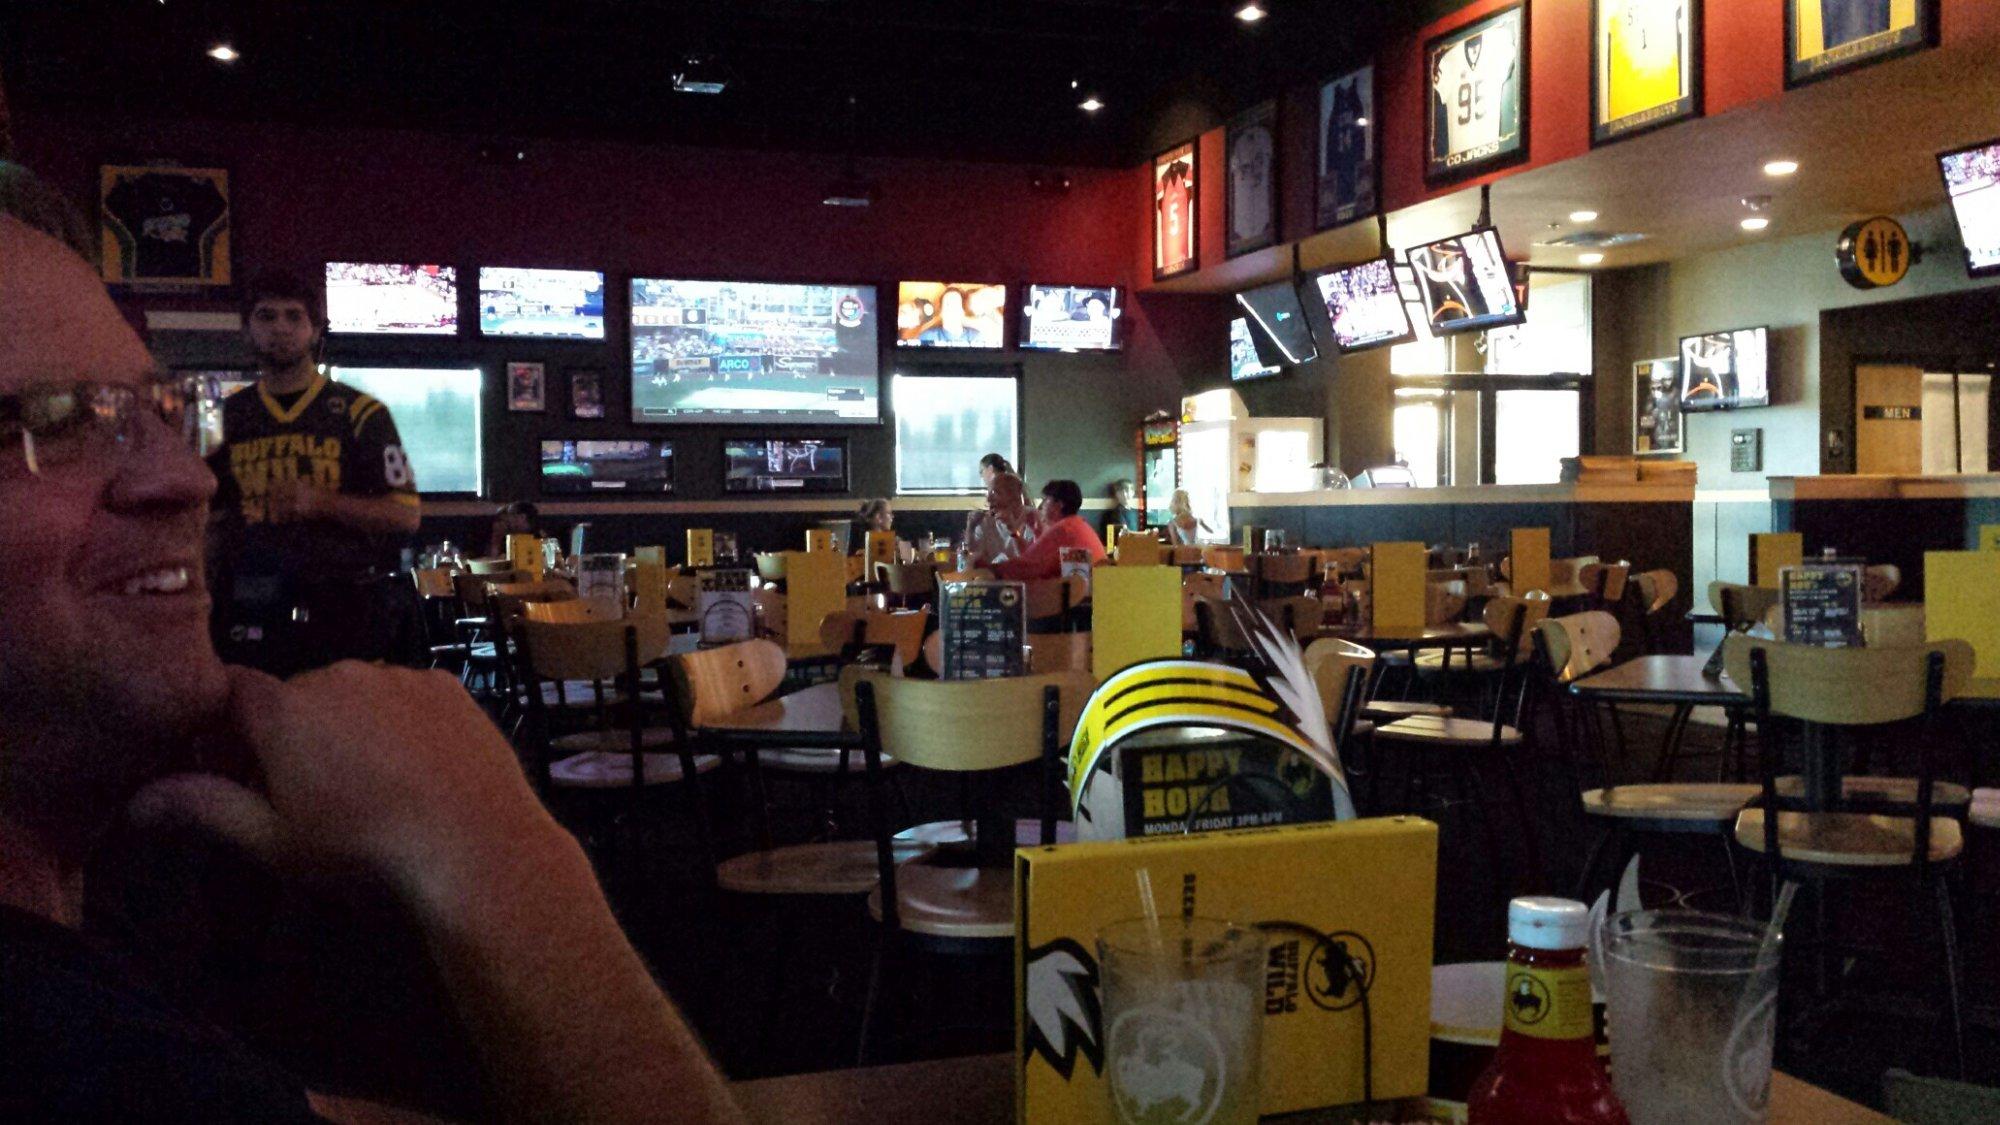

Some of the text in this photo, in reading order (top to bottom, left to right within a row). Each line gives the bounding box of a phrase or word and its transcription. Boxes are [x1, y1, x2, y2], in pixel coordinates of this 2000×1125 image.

[1169, 202, 1178, 236] 5
[720, 359, 749, 369] ARCO
[1884, 407, 1910, 419] MEN
[230, 433, 342, 464] BUFFALO
[1141, 748, 1242, 783] HAPPY
